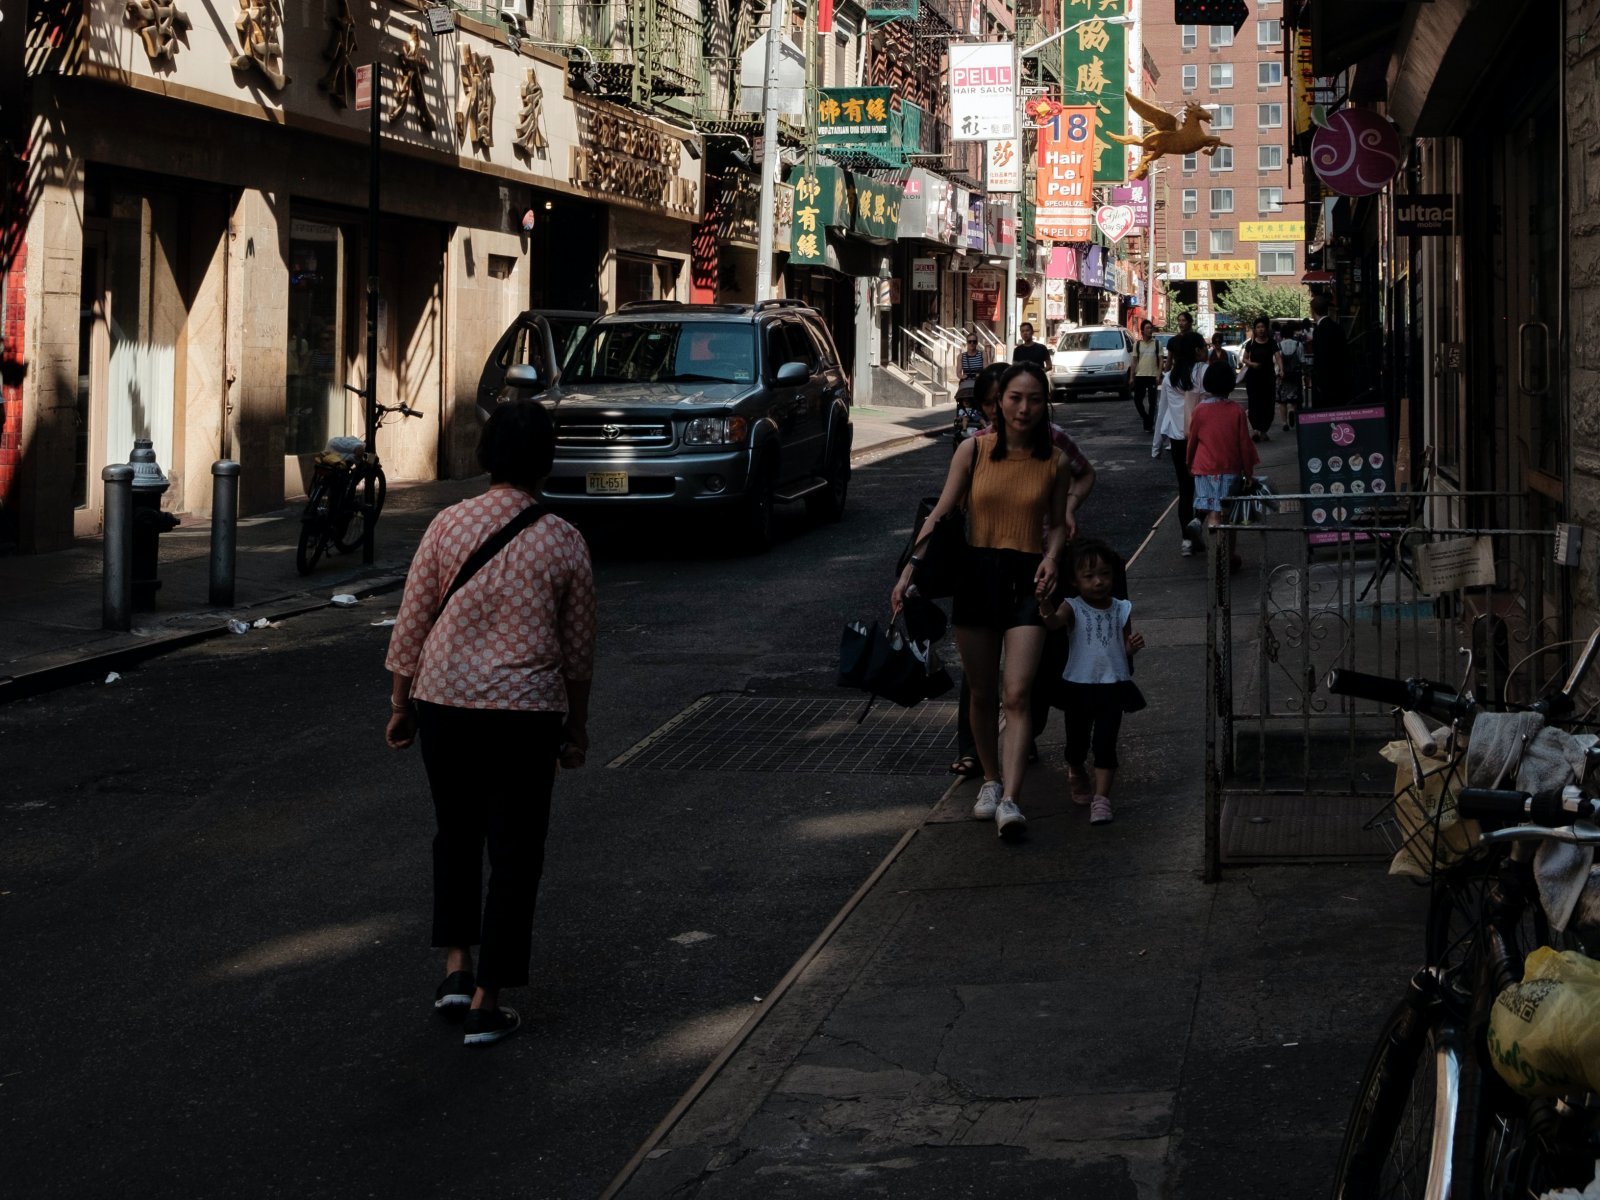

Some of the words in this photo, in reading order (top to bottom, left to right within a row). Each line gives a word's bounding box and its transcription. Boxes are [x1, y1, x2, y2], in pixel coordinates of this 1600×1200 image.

[954, 66, 1011, 86] PELL
[872, 125, 887, 133] HOUSE
[1047, 113, 1088, 143] 18
[1046, 151, 1084, 164] Hair
[1053, 167, 1075, 180] Le
[1048, 183, 1081, 196] Pell
[1398, 204, 1442, 221] ultra
[1051, 228, 1075, 236] PELL
[1077, 228, 1088, 236] ST
